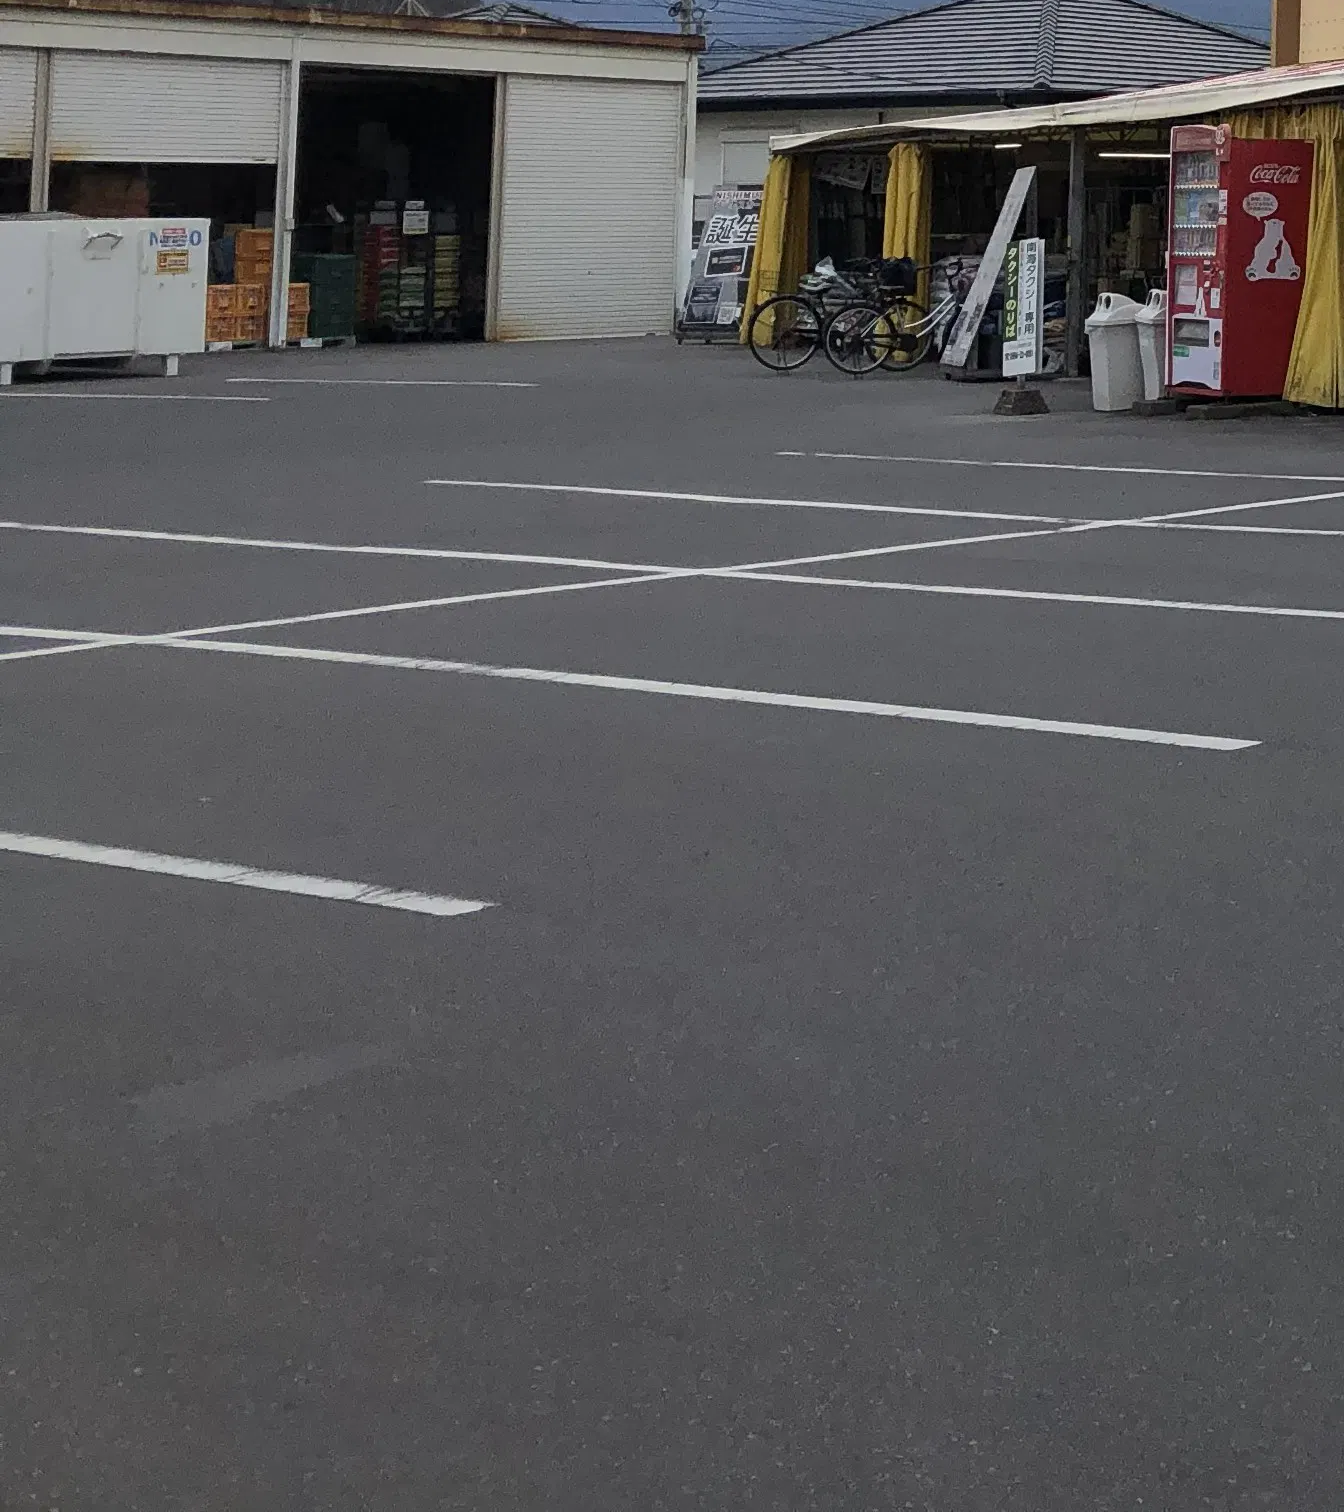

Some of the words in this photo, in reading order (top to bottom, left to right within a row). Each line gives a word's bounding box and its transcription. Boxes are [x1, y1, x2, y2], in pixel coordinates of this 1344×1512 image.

[1005, 247, 1018, 338] タクシーのりば
